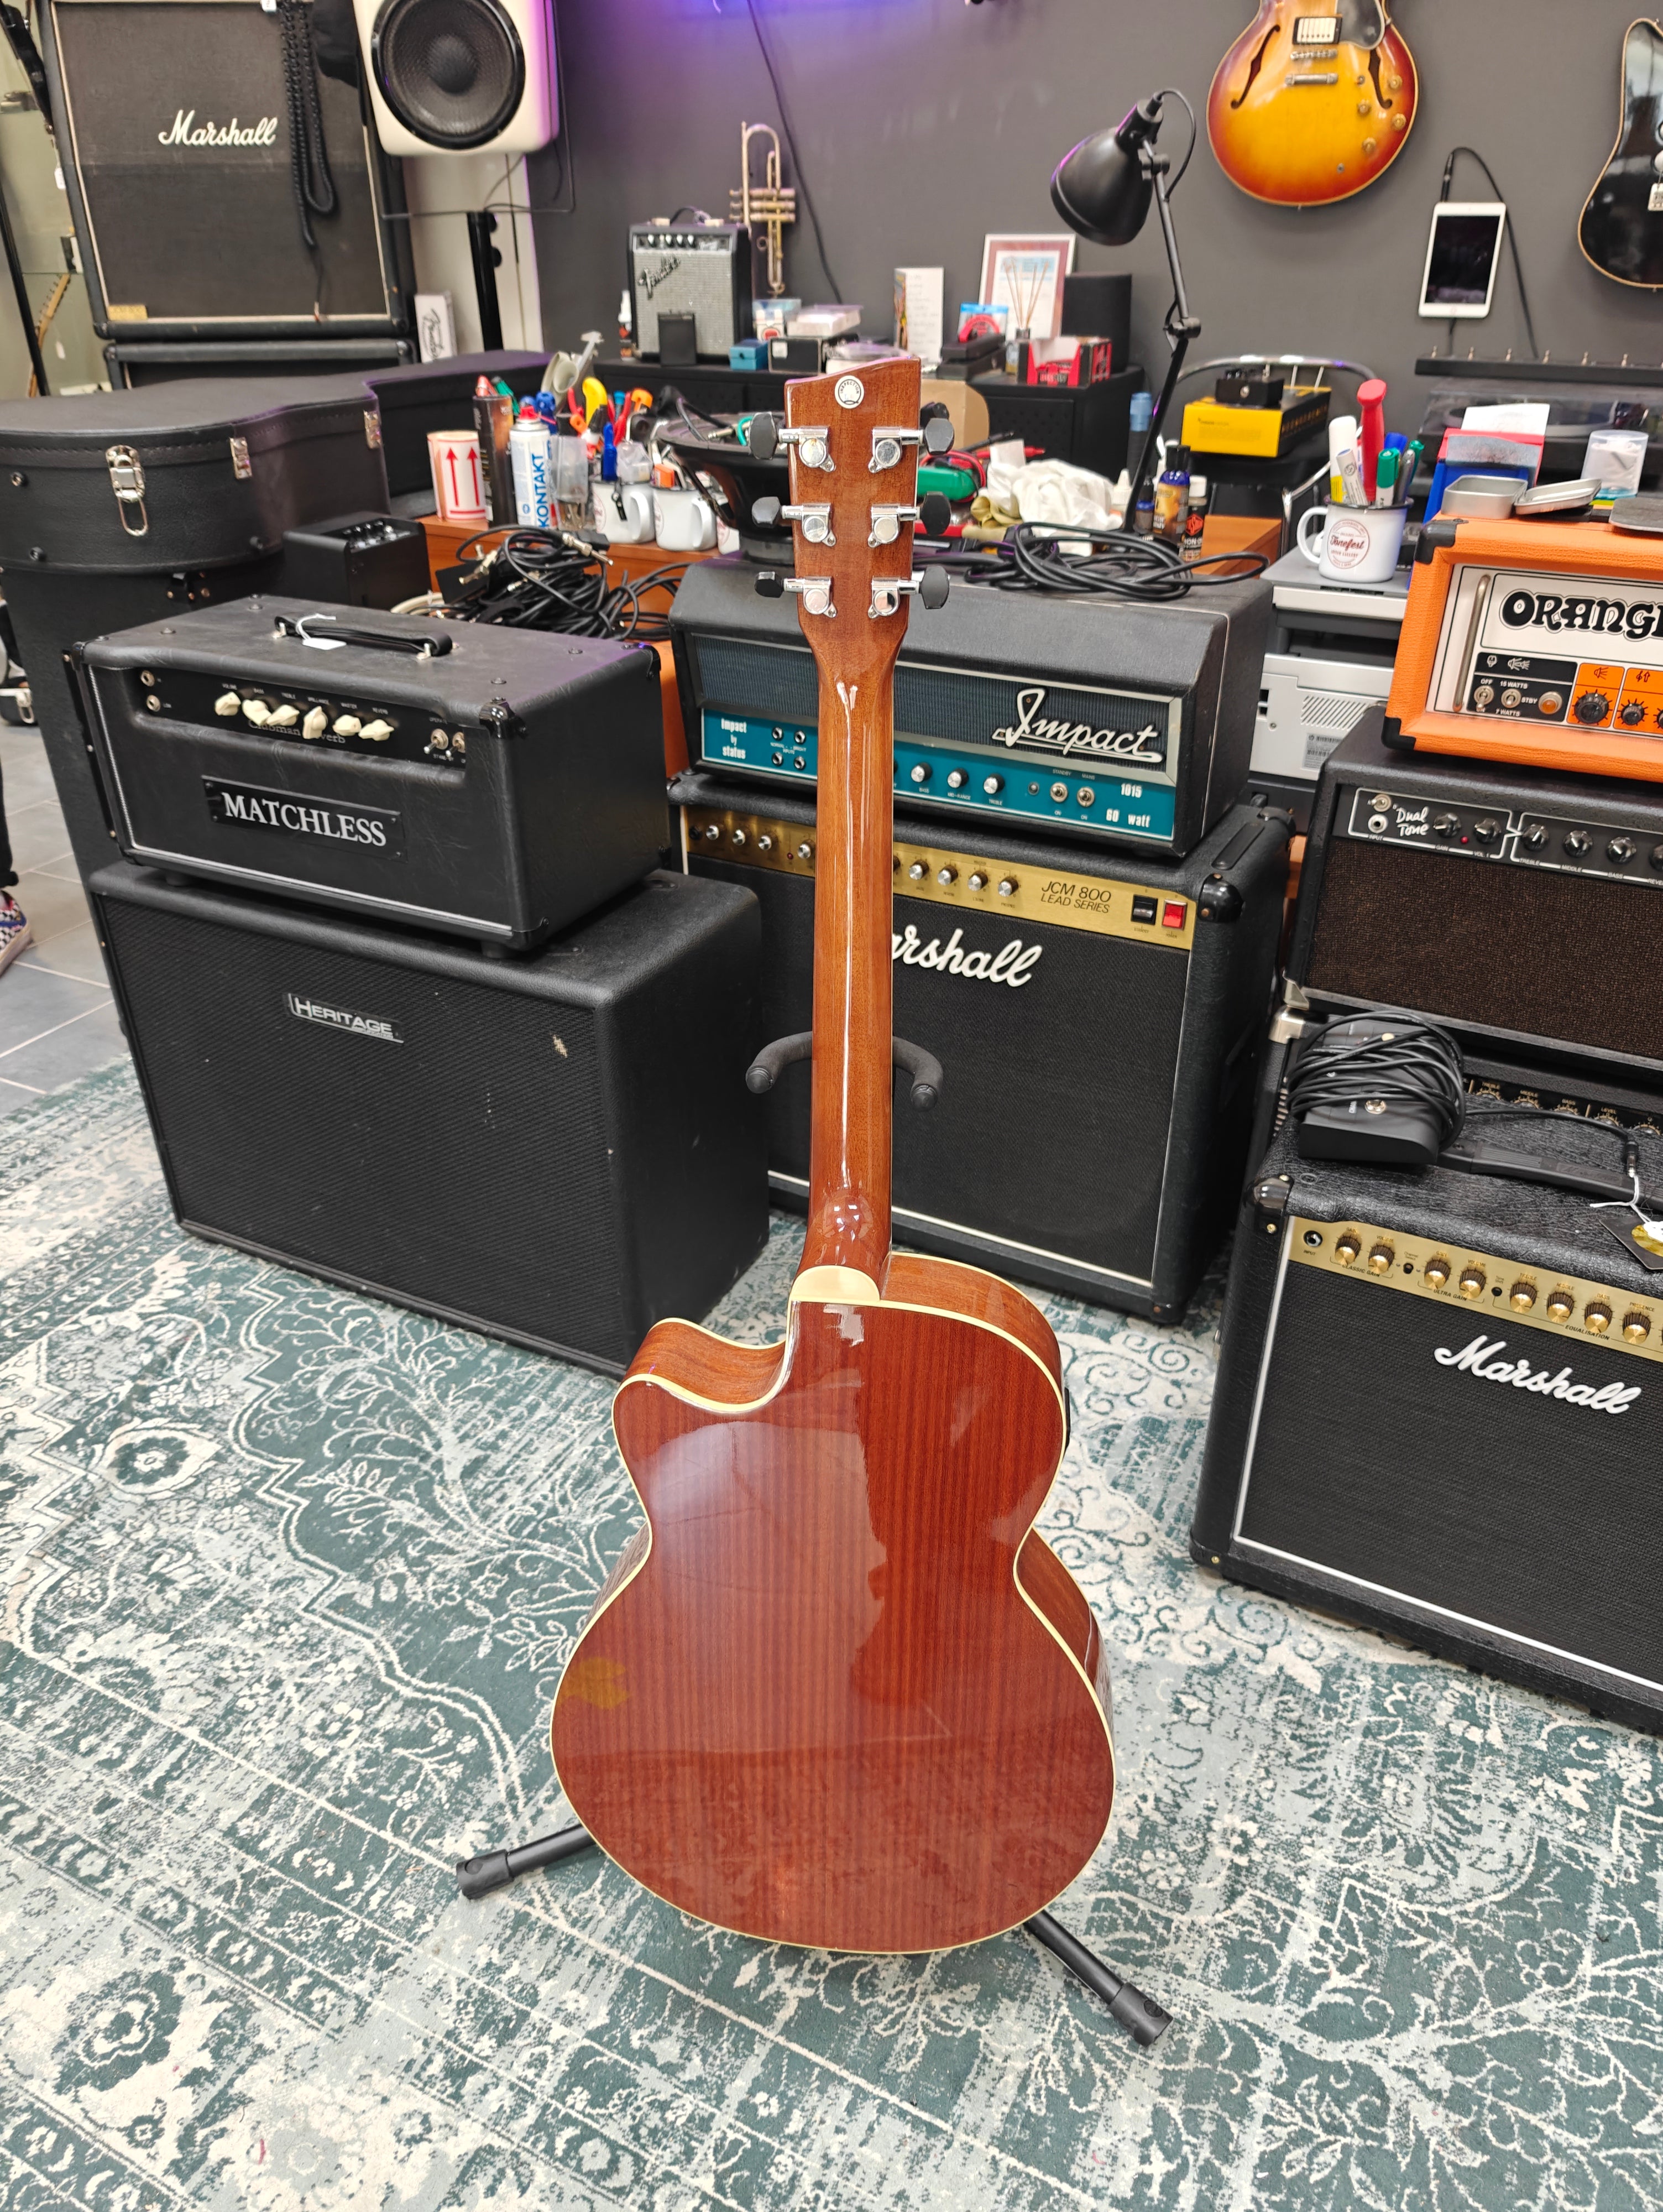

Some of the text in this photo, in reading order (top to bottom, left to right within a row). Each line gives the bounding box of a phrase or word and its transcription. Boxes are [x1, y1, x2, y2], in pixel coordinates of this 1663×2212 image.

[158, 109, 278, 146] Marshall
[840, 380, 860, 394] INSPECTION
[532, 453, 549, 529] KONTAKT
[1500, 590, 1663, 640] ORANG
[721, 718, 747, 733] Impact
[992, 688, 1163, 763] Impact
[730, 734, 738, 746] by
[723, 746, 746, 760] status
[1121, 782, 1142, 799] 1015
[222, 791, 387, 847] MATCHLESS
[1106, 808, 1151, 828] 60 watt
[1395, 806, 1430, 823] Dual
[1397, 823, 1430, 837] Tone
[1520, 858, 1540, 867] TREBLE
[1561, 864, 1583, 873] MIDDLE
[1608, 870, 1624, 879] BASS
[1042, 881, 1112, 903] JCM 800
[1040, 893, 1111, 914] LEAD SERIES
[294, 997, 394, 1036] HERITAGE
[1467, 1259, 1486, 1268] VOLUME
[1433, 1288, 1451, 1298] ULTRA
[1557, 1282, 1575, 1291] MIDDLE
[1629, 1301, 1655, 1312] PRESENCE
[1565, 1324, 1610, 1341] EQUALISATION
[1434, 1334, 1641, 1414] Marshall
